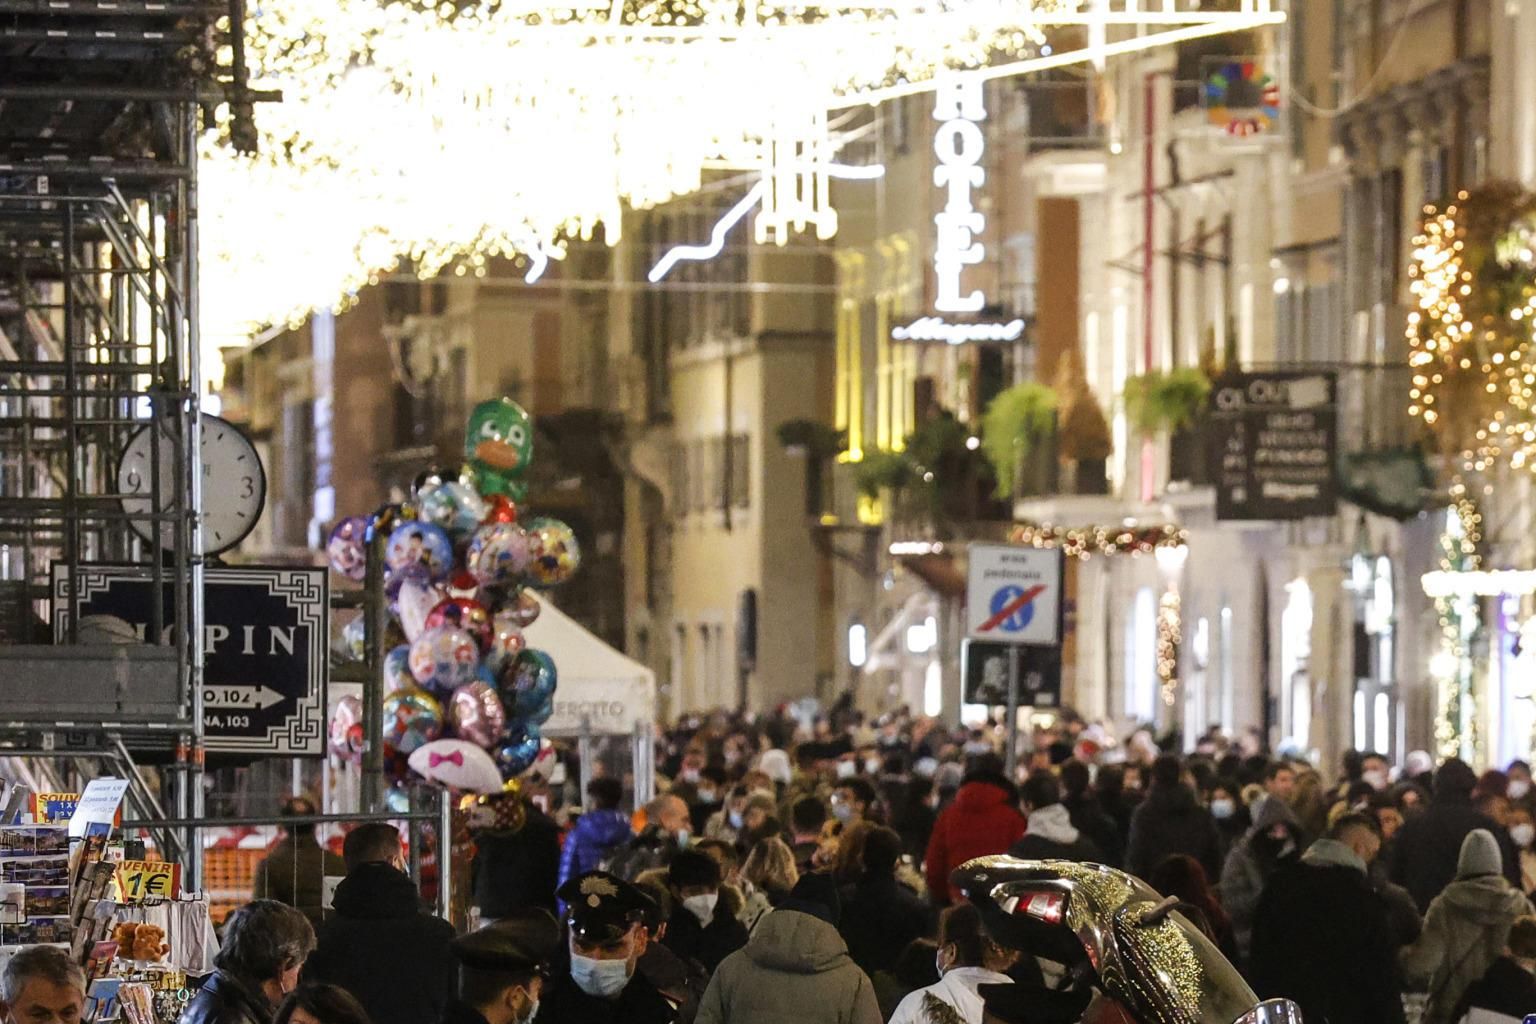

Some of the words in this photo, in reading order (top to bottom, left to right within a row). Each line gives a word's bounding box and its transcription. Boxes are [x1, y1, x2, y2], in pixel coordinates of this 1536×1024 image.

[933, 70, 986, 312] HOTEL
[241, 476, 254, 499] 3
[39, 794, 81, 803] SOUV
